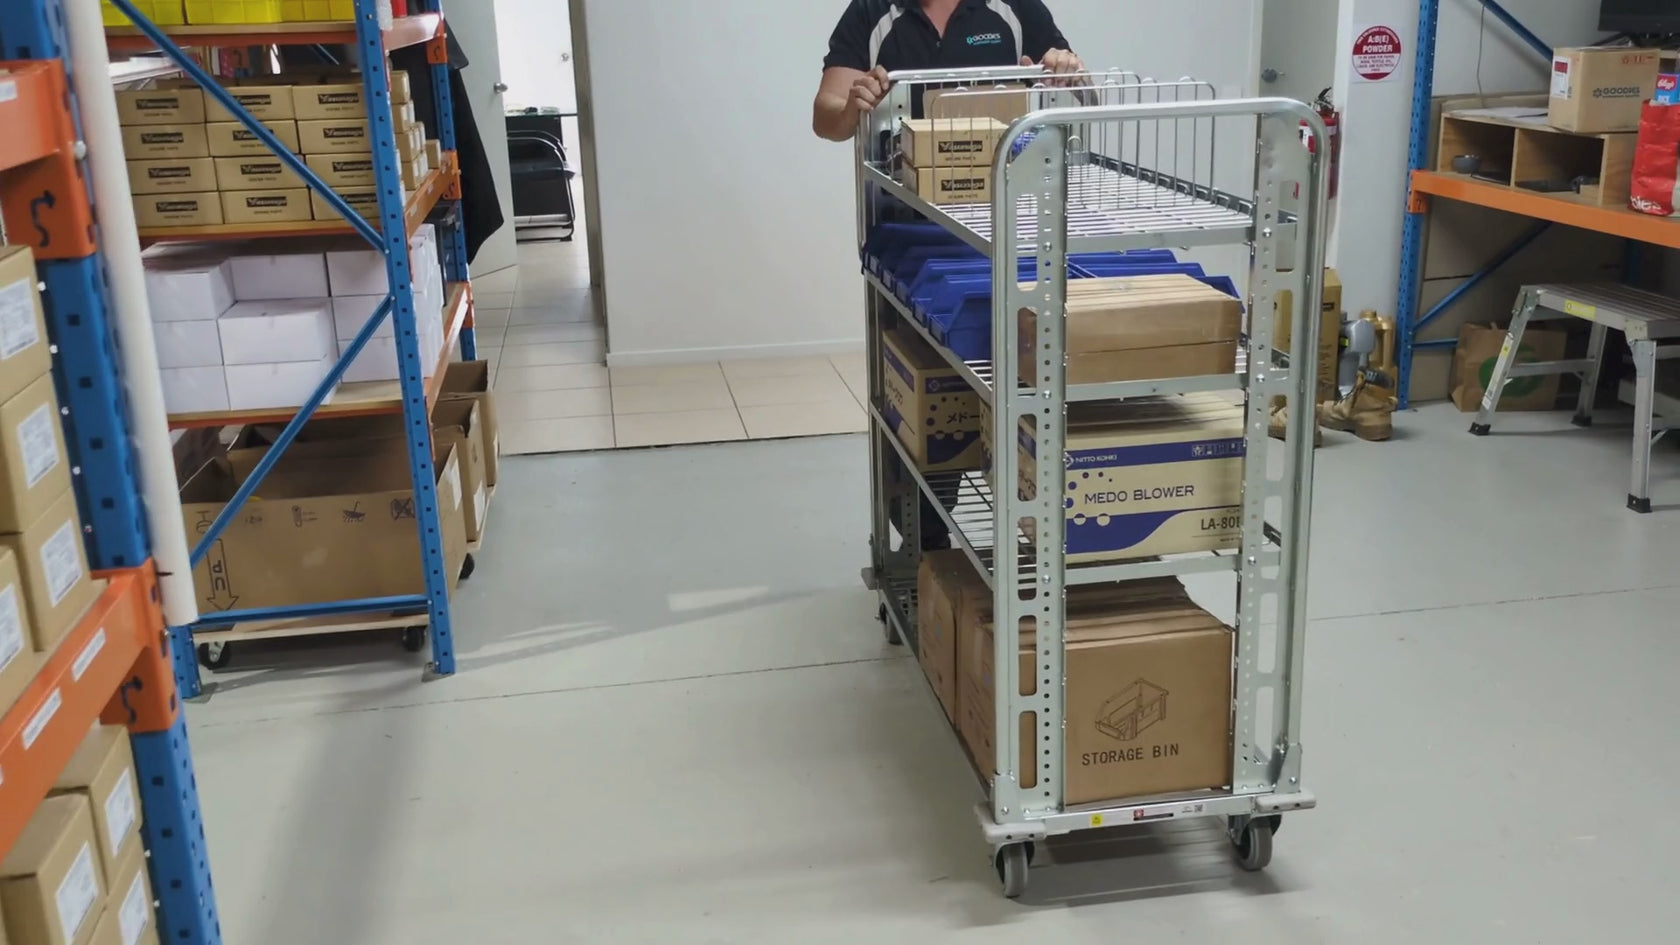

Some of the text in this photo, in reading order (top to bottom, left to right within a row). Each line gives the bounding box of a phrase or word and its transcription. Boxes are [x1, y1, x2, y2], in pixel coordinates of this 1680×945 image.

[1363, 45, 1393, 53] POWDER
[1603, 86, 1640, 95] GOODIES
[1096, 454, 1118, 462] KOHKI
[1084, 485, 1195, 504] MEDO BLOWER
[1081, 743, 1179, 766] STORAGE BIN
